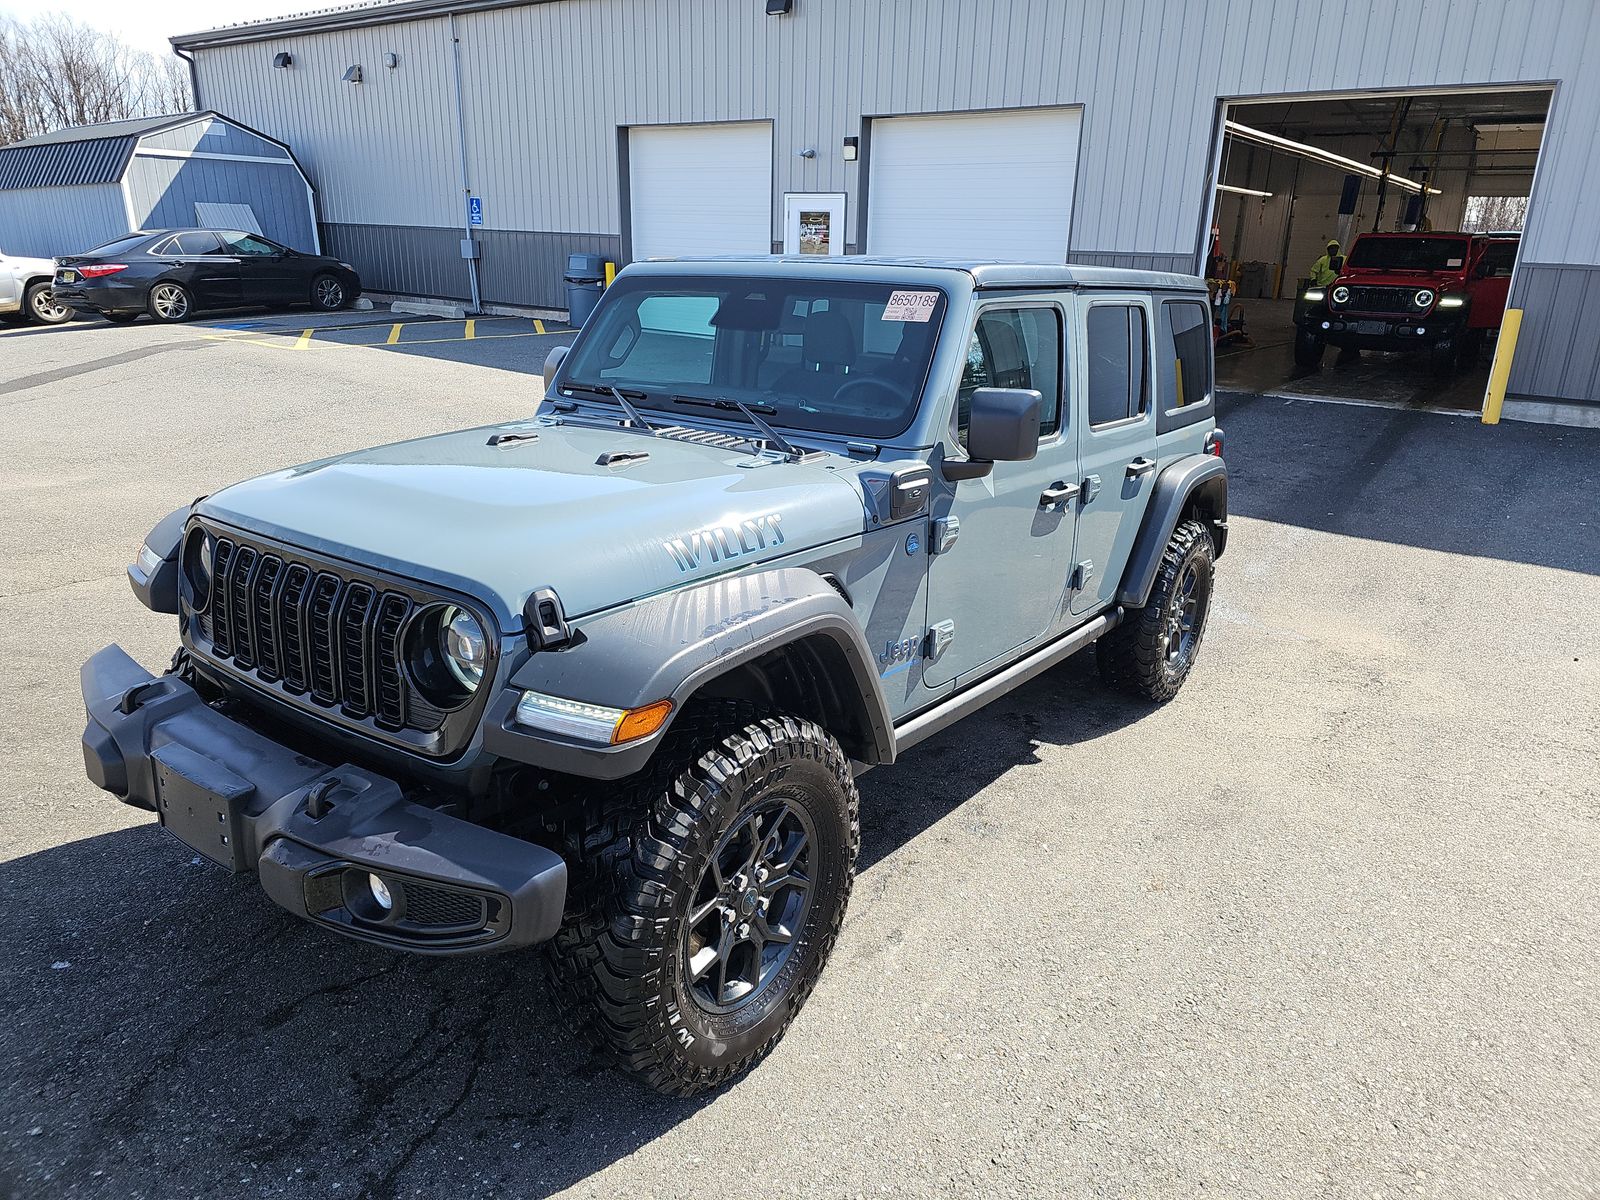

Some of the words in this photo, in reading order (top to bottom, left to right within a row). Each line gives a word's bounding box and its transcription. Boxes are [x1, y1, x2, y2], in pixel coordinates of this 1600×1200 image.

[890, 294, 937, 307] 8650189
[662, 513, 784, 572] WILLYS
[879, 635, 919, 664] Jeep
